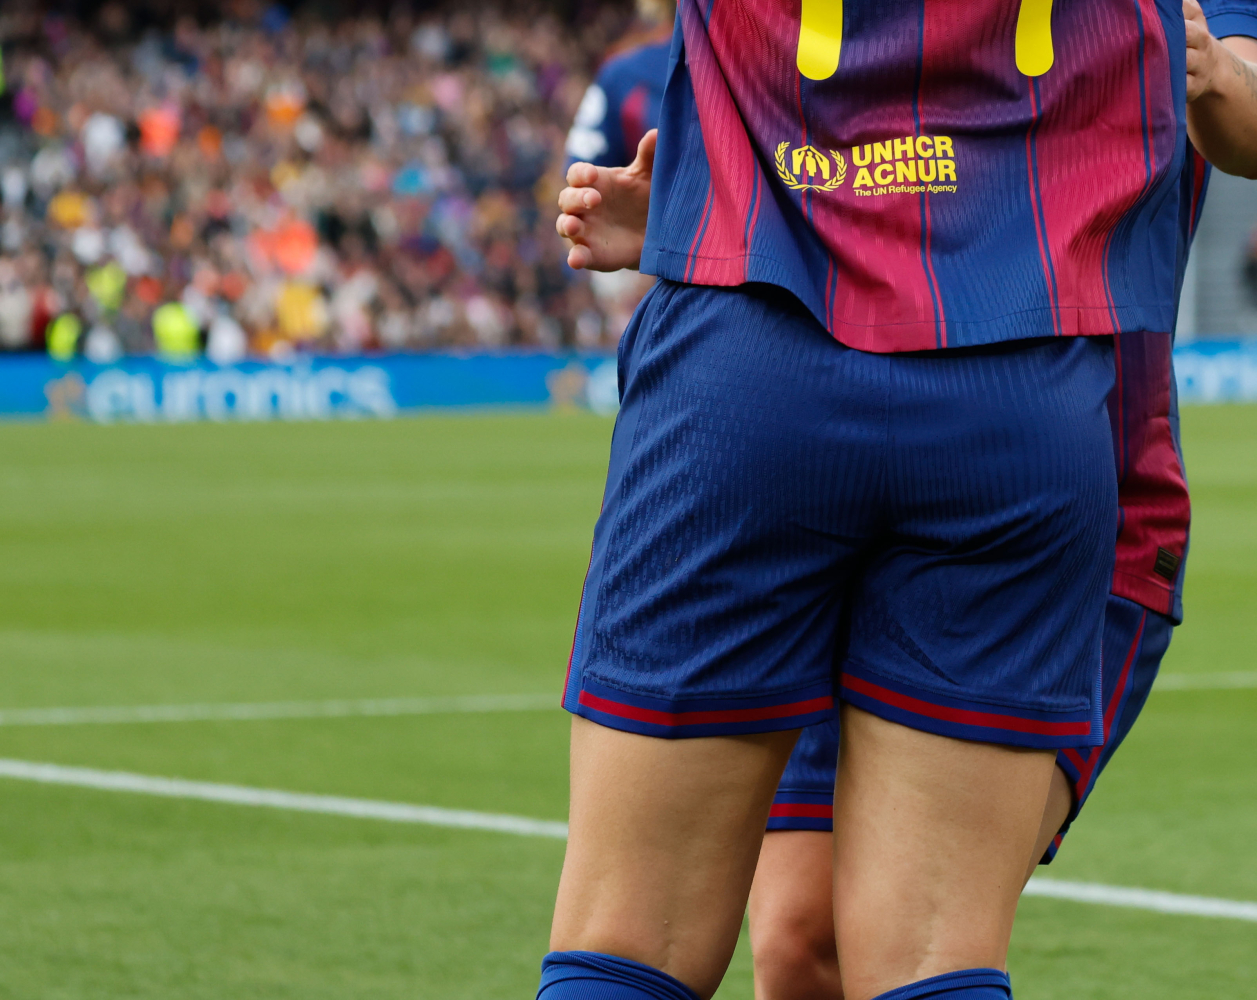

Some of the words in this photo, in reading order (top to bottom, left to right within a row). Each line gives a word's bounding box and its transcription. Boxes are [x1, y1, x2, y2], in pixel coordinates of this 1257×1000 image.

[851, 136, 955, 167] UNHCR
[852, 159, 957, 188] ACNUR
[854, 188, 872, 197] The
[872, 187, 887, 196] UN
[888, 185, 926, 195] Refugee
[927, 184, 957, 194] Agency
[86, 356, 399, 424] euronics
